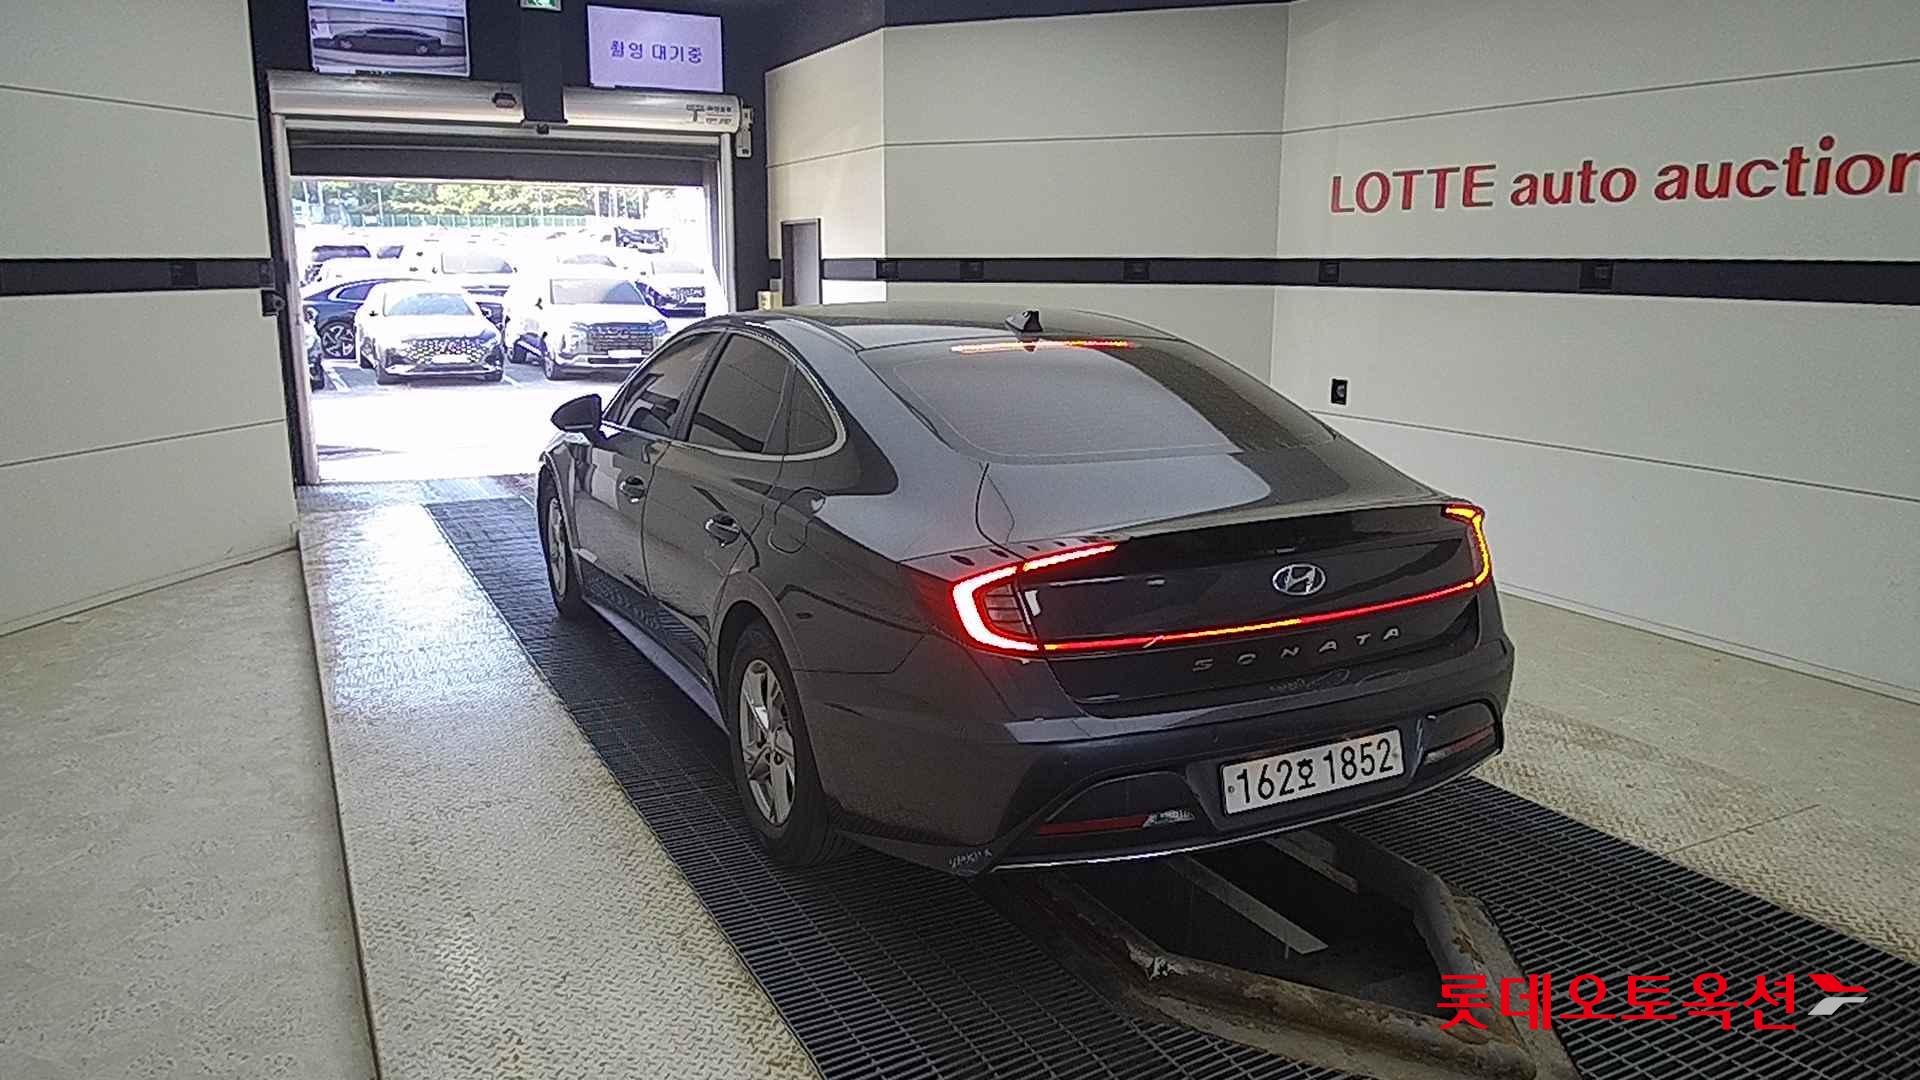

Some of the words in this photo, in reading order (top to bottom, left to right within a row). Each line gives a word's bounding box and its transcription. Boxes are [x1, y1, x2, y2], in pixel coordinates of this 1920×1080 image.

[652, 43, 702, 64] 대기중
[1330, 163, 1497, 214] LOTTE
[1510, 159, 1637, 207] auto
[1192, 627, 1400, 672] SONATA
